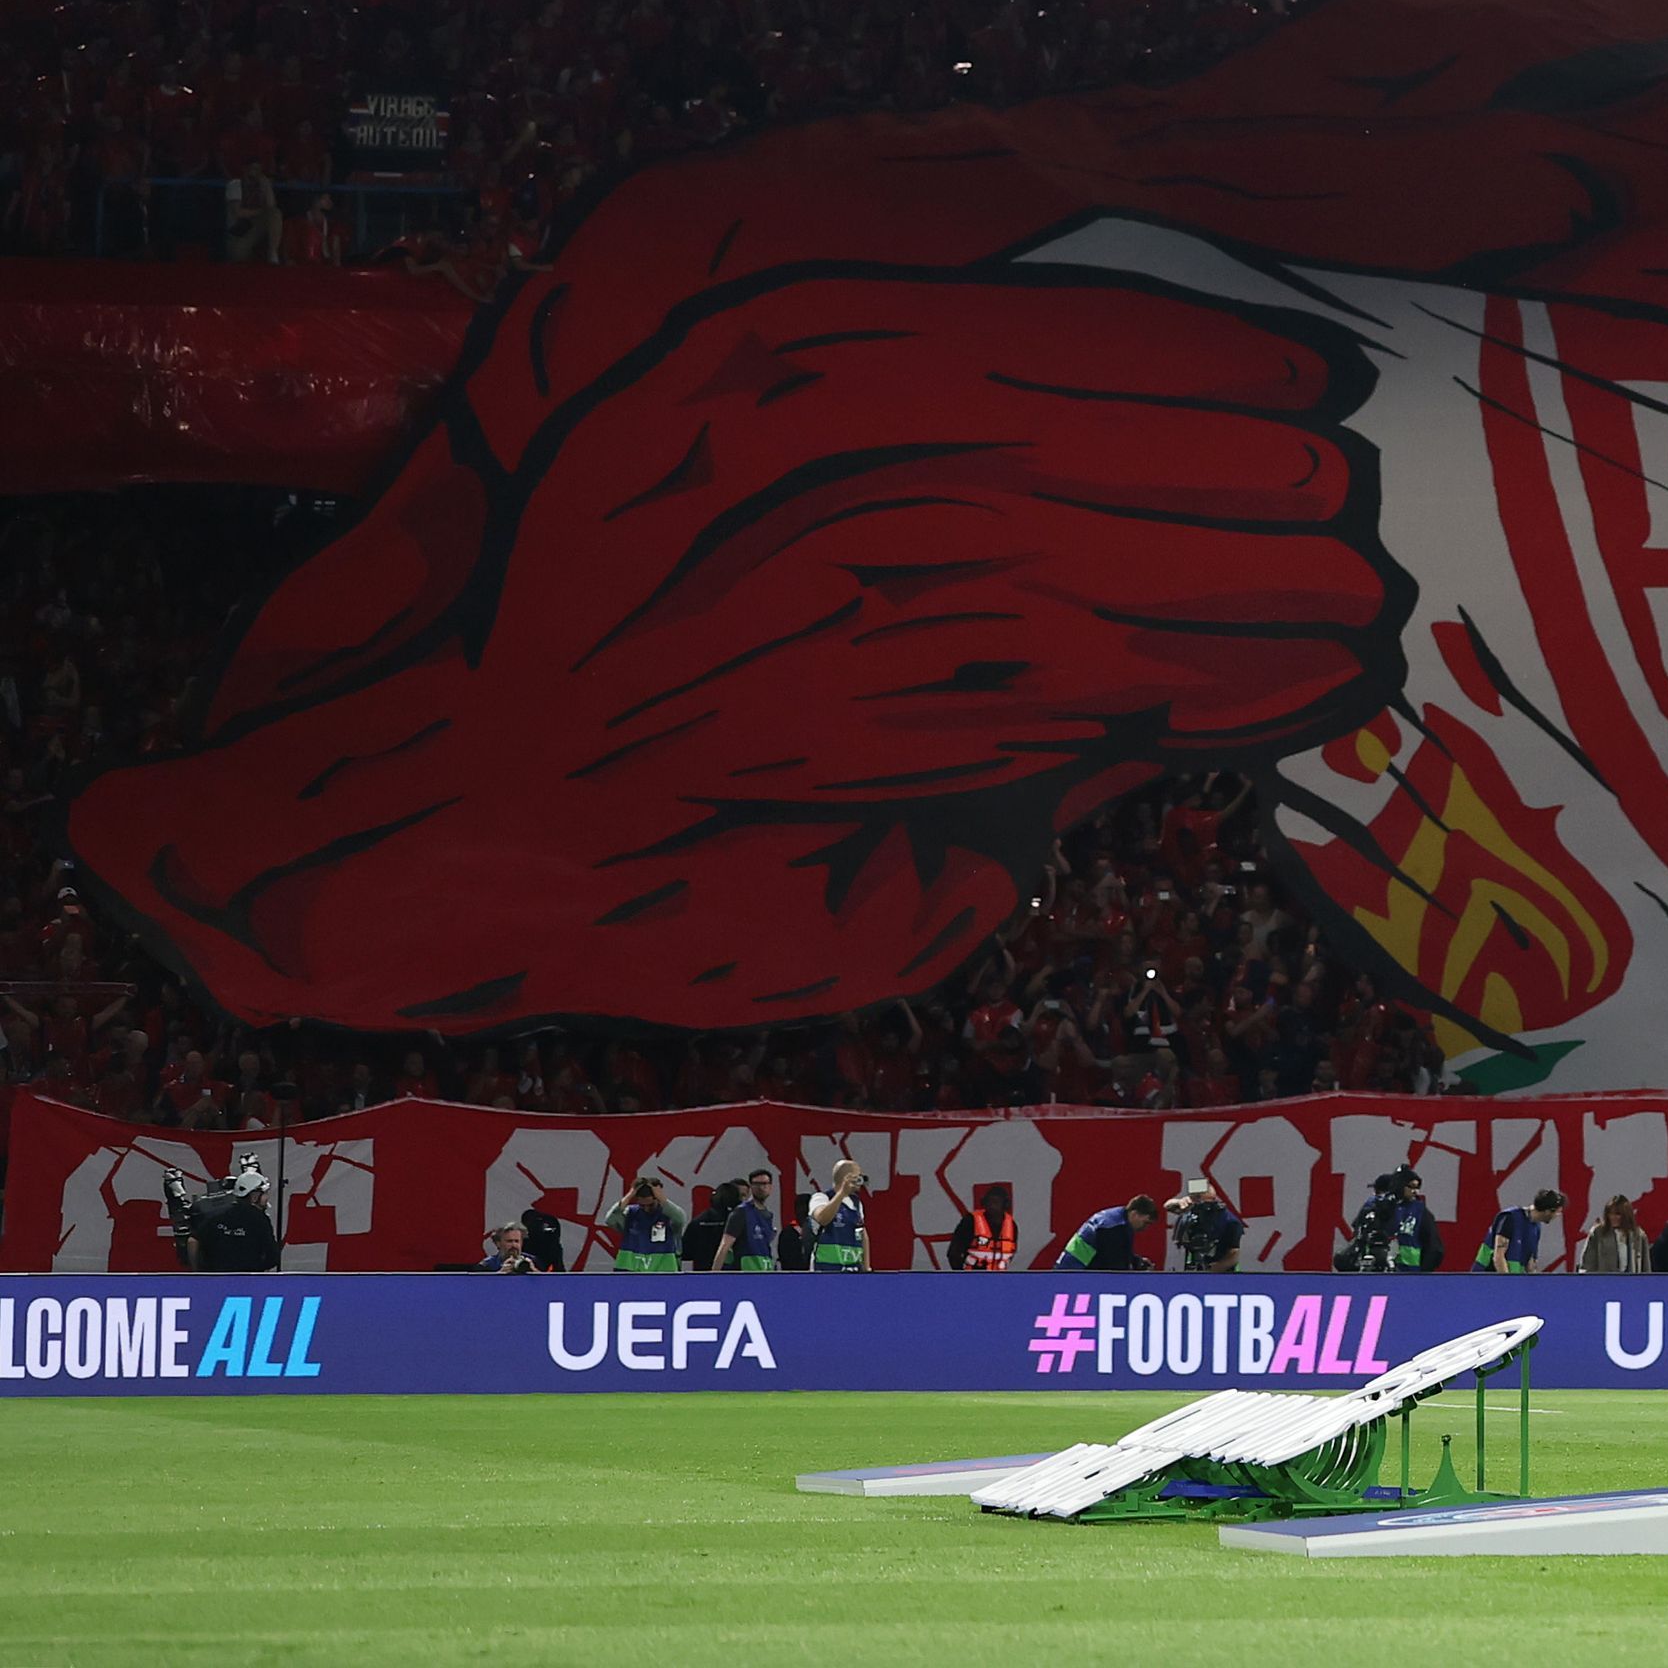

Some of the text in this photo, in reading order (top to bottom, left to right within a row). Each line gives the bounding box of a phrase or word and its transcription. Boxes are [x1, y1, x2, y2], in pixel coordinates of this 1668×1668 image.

[196, 1295, 322, 1378] ALL
[548, 1299, 778, 1371] UEFA
[1029, 1293, 1389, 1375] #FOOTBALL
